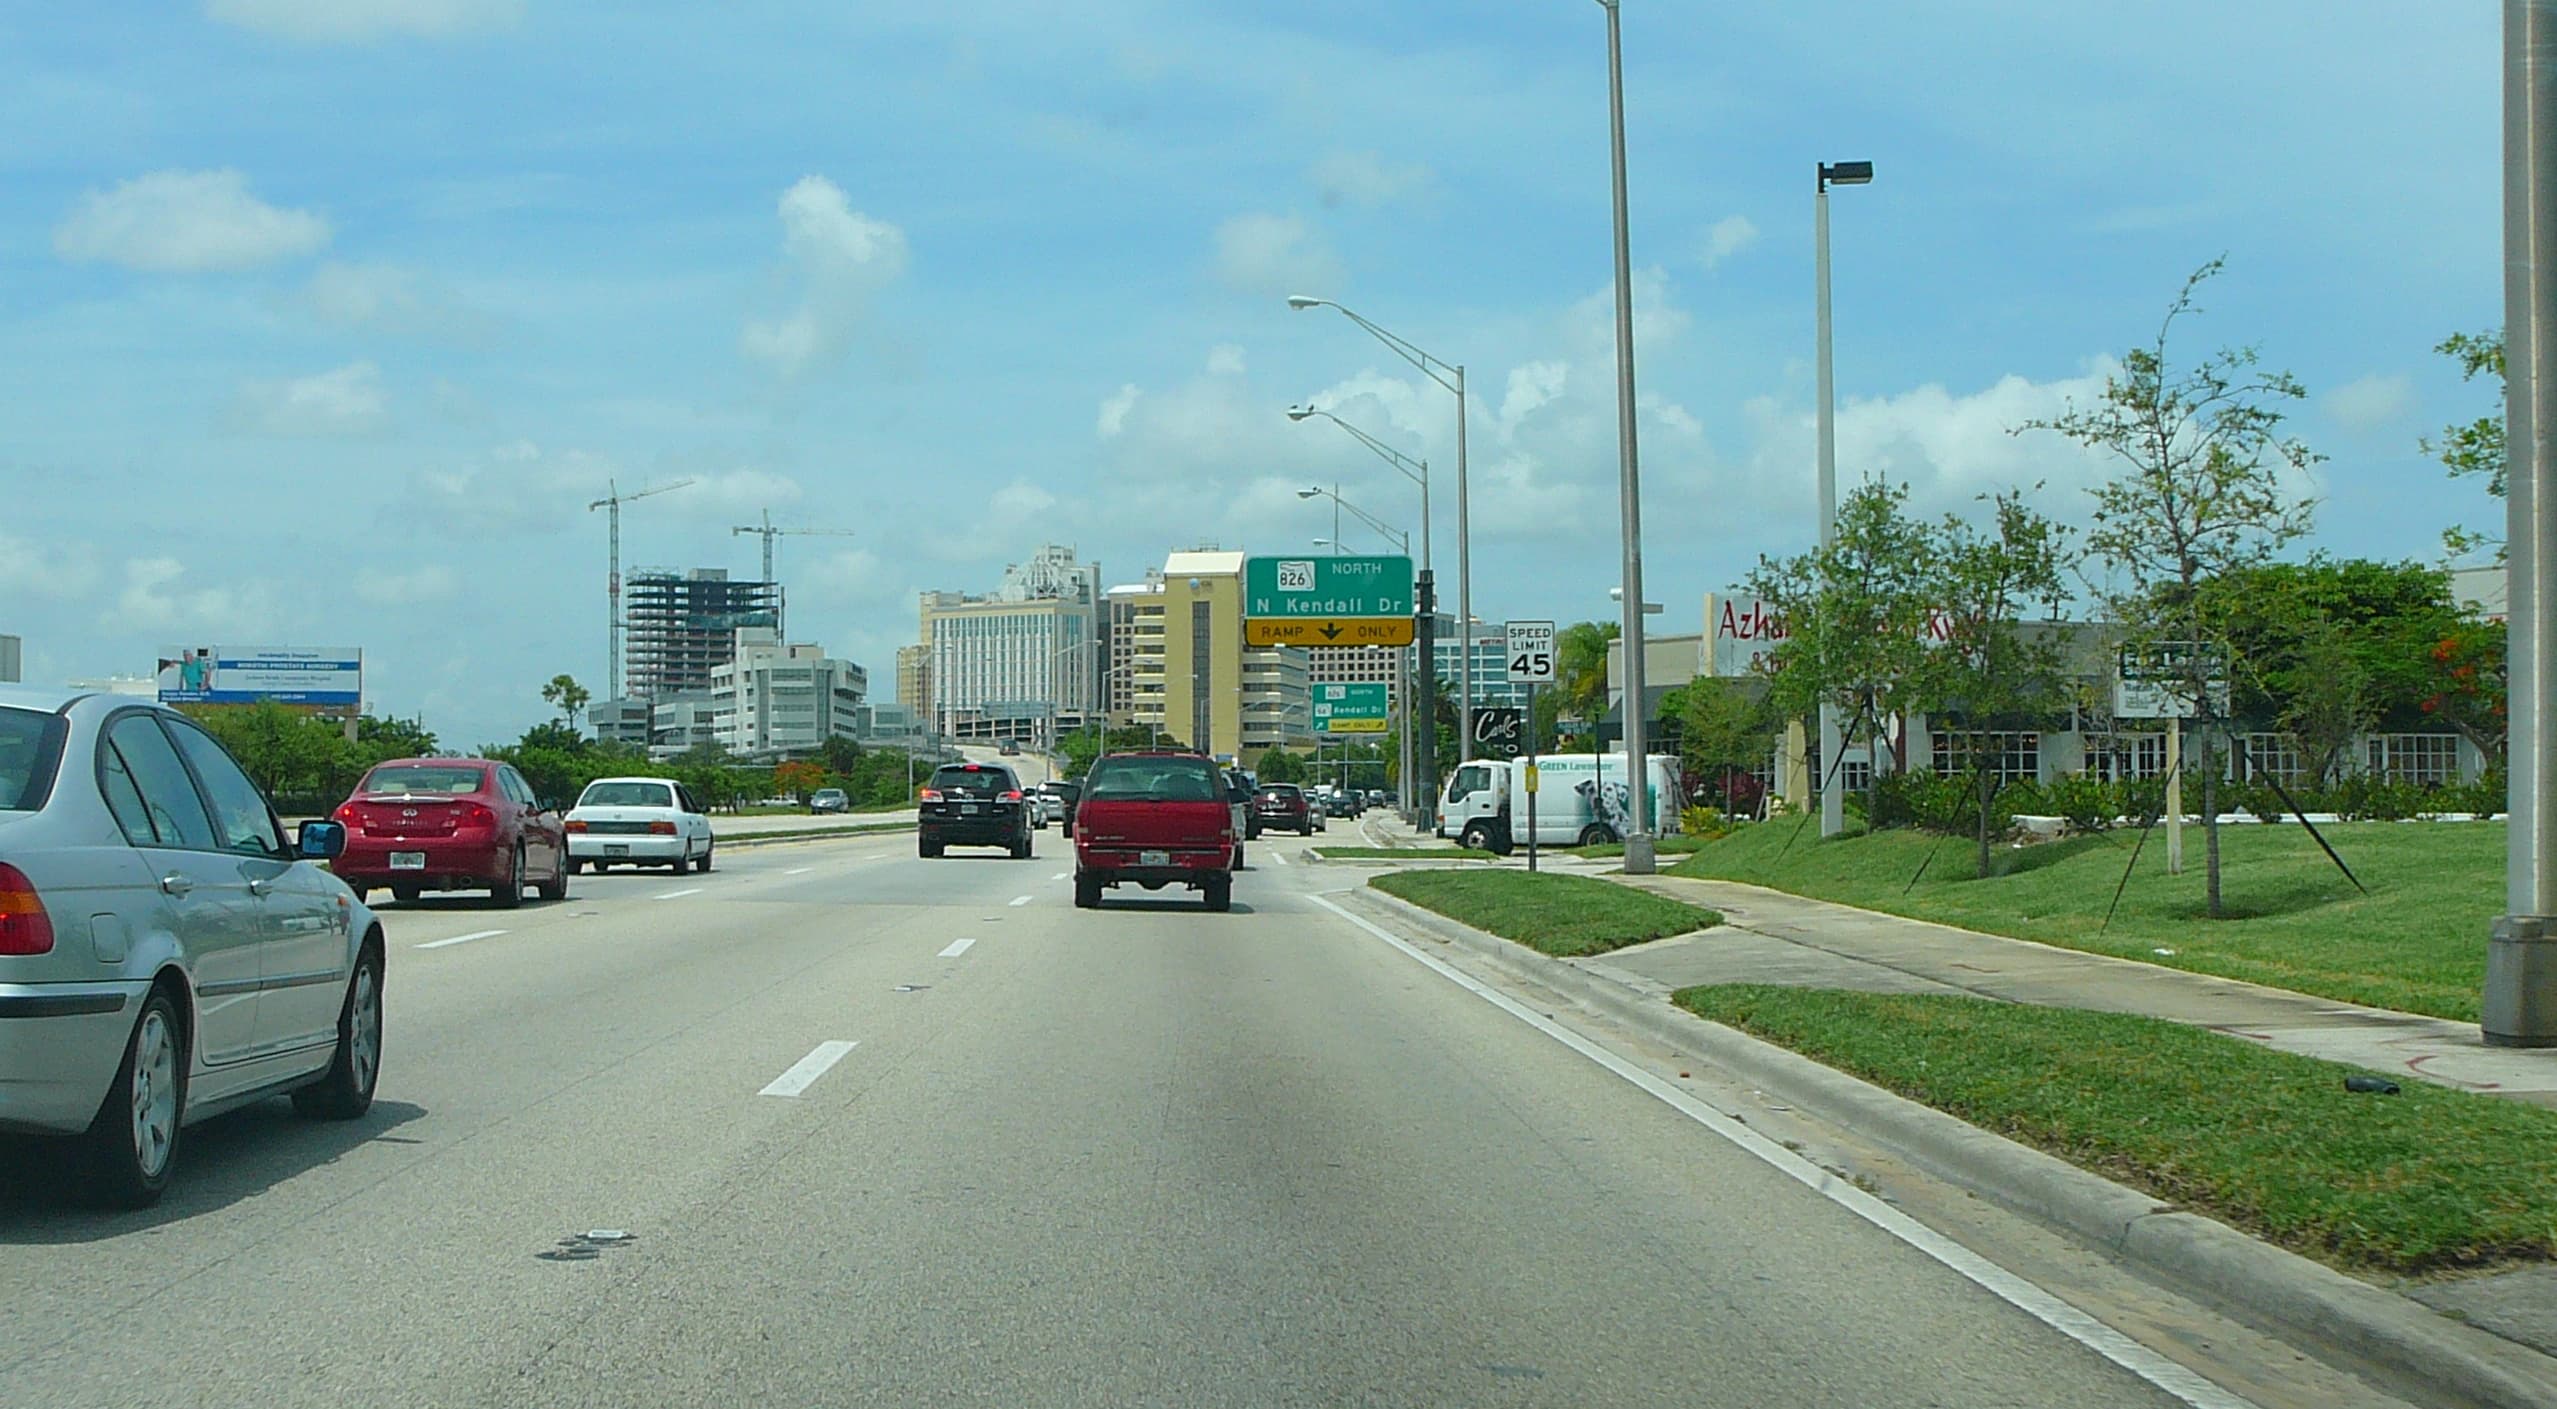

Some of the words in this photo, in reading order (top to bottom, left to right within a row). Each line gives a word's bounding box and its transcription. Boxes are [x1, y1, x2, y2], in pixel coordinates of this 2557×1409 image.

[1279, 573, 1306, 586] 826
[1332, 563, 1382, 574] NORTH
[1257, 598, 1269, 612] N
[1287, 598, 1362, 612] Kendall
[1379, 598, 1401, 612] Dr
[1262, 626, 1304, 637] RAMP
[1358, 626, 1397, 637] ONLY
[1509, 628, 1551, 638] SPEED
[1512, 641, 1547, 651] LIMIT
[1510, 653, 1550, 675] 45
[1334, 706, 1368, 714] Kendall
[1371, 706, 1382, 714] Dr
